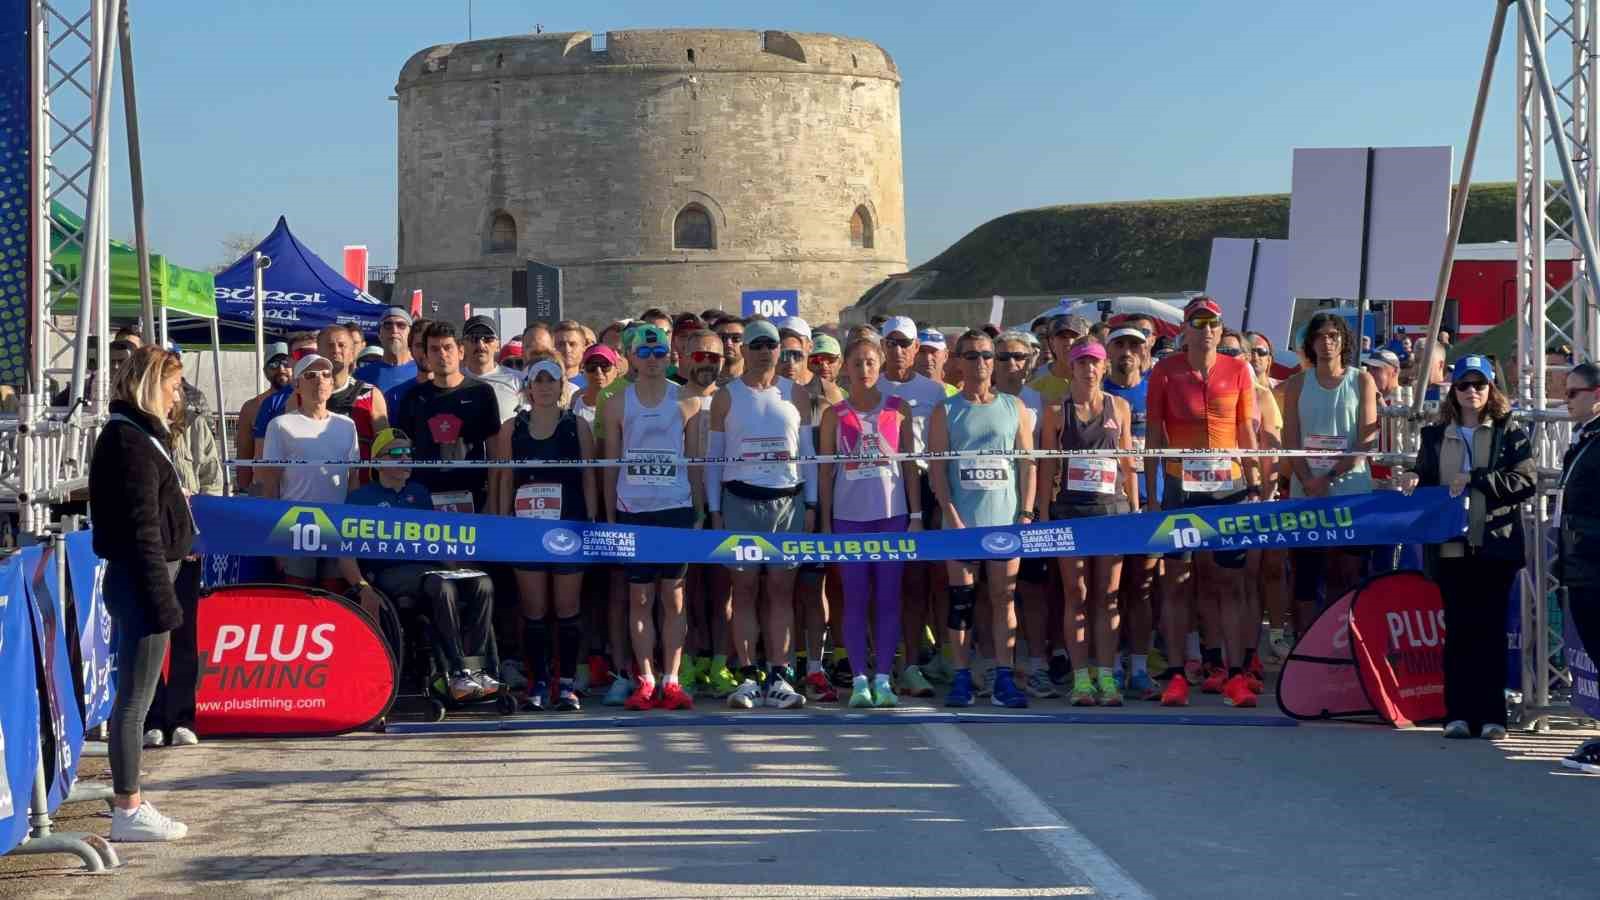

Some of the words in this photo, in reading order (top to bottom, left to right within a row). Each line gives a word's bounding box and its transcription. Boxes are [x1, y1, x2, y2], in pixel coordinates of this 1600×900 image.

[752, 299, 788, 317] 10K
[633, 465, 671, 475] 1137
[966, 469, 1004, 480] 1081
[528, 498, 545, 509] 16
[1221, 528, 1355, 546] MARATONU
[341, 542, 476, 556] MARATONU
[783, 552, 917, 561] MARATONU
[212, 624, 336, 662] PLUS
